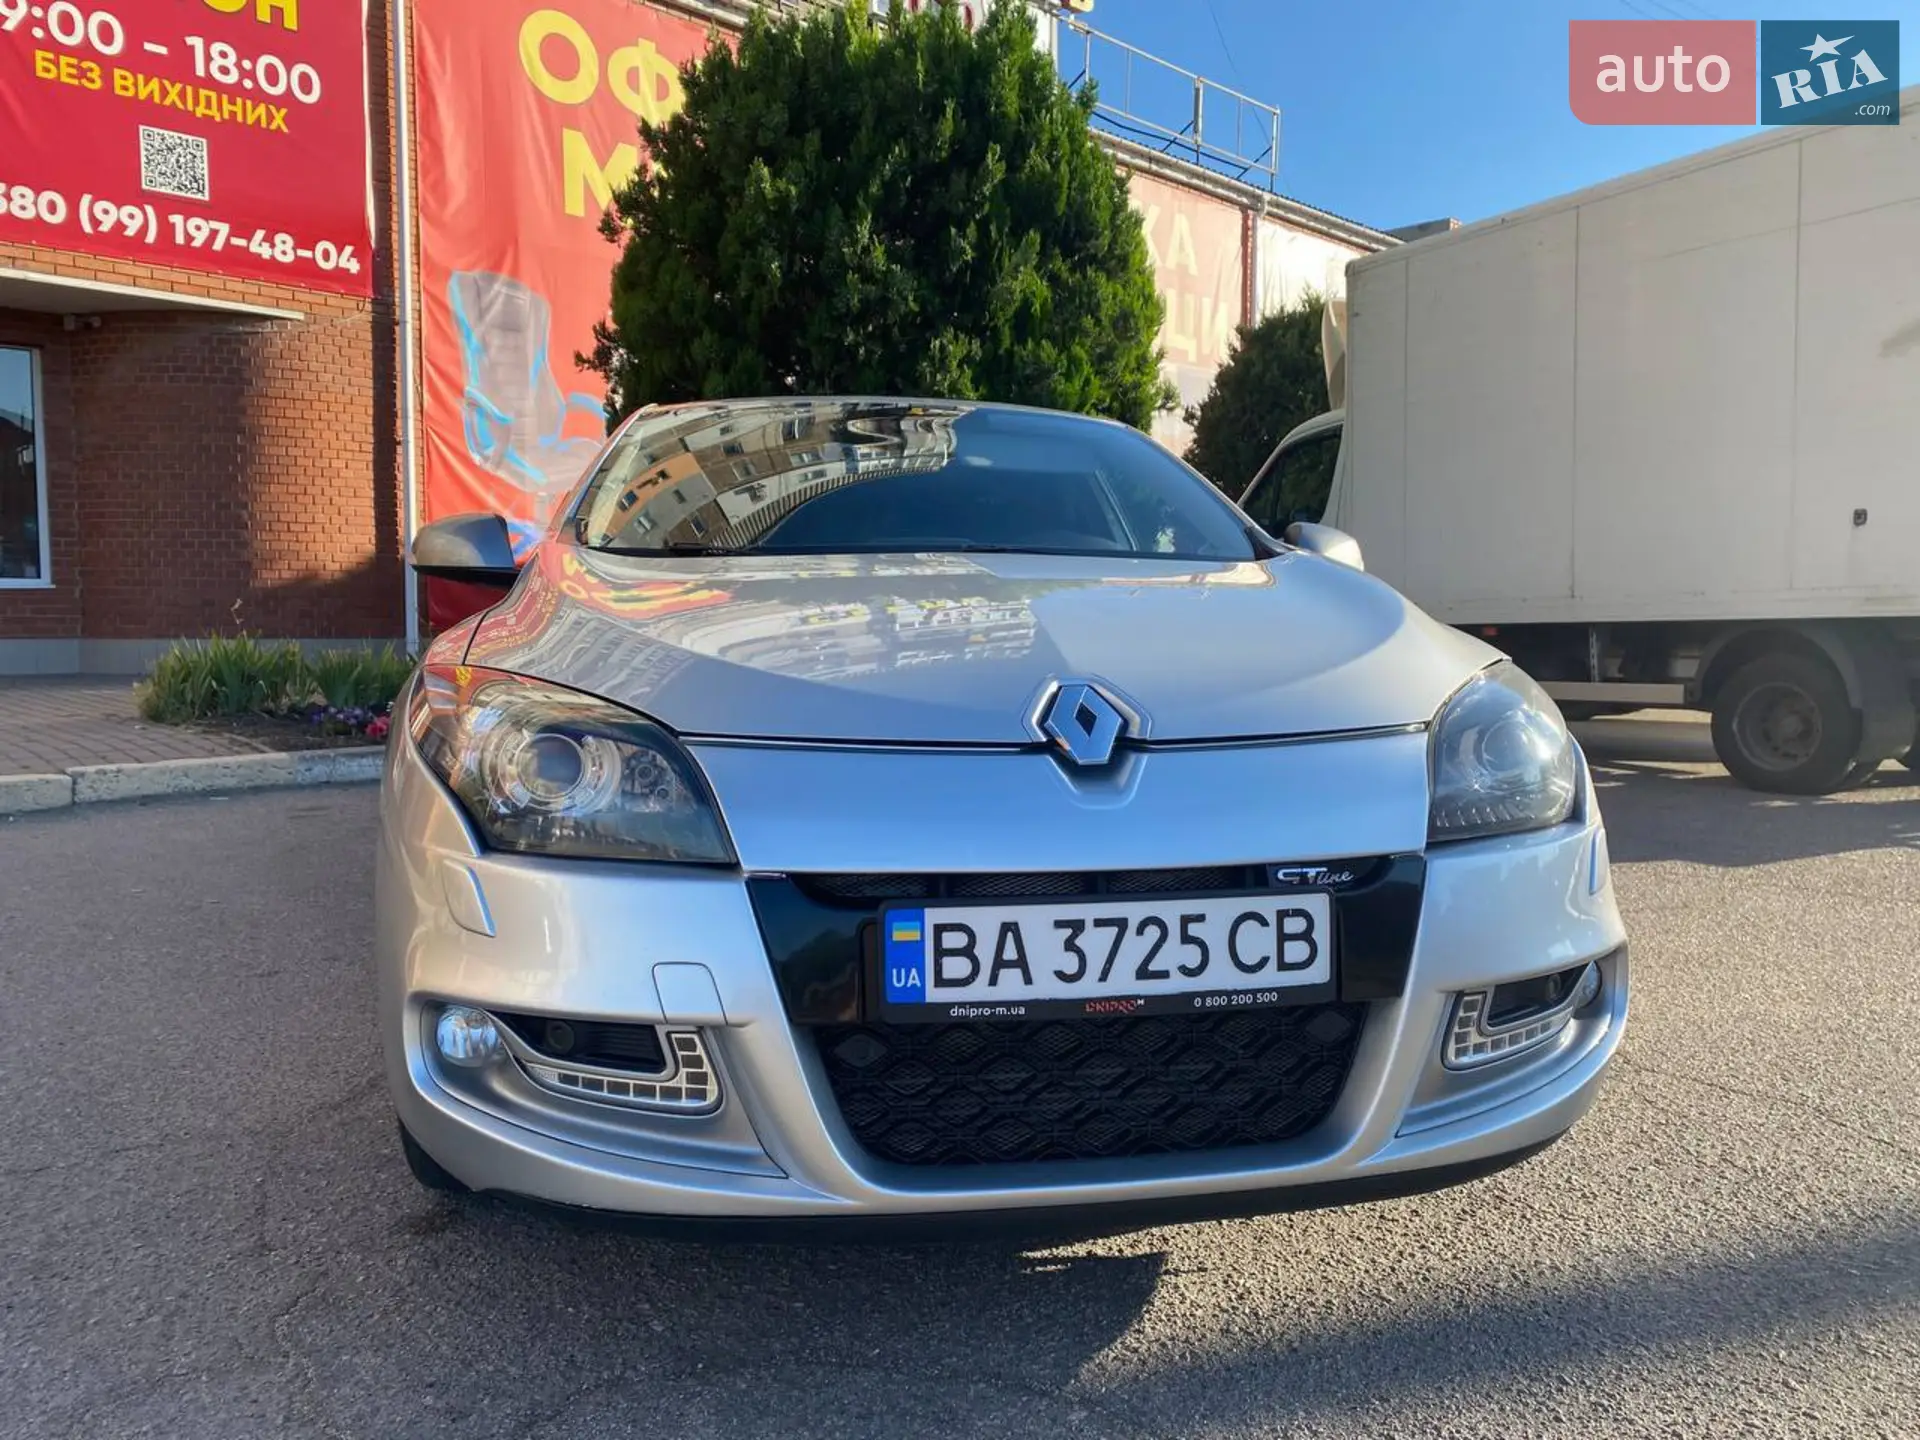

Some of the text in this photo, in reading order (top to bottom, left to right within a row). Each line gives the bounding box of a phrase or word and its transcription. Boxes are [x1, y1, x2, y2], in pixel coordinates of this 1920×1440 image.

[34, 49, 289, 133] БЕЗ ВИХІДНИХ
[184, 36, 321, 104] 18:00
[79, 193, 157, 244] (99)
[168, 214, 360, 274] 197-48-04
[891, 967, 922, 988] UA
[932, 908, 1318, 989] BA 3725 CB
[949, 1005, 1026, 1018] dnipro-m.ua
[1193, 992, 1278, 1007] 0 800 200 500
